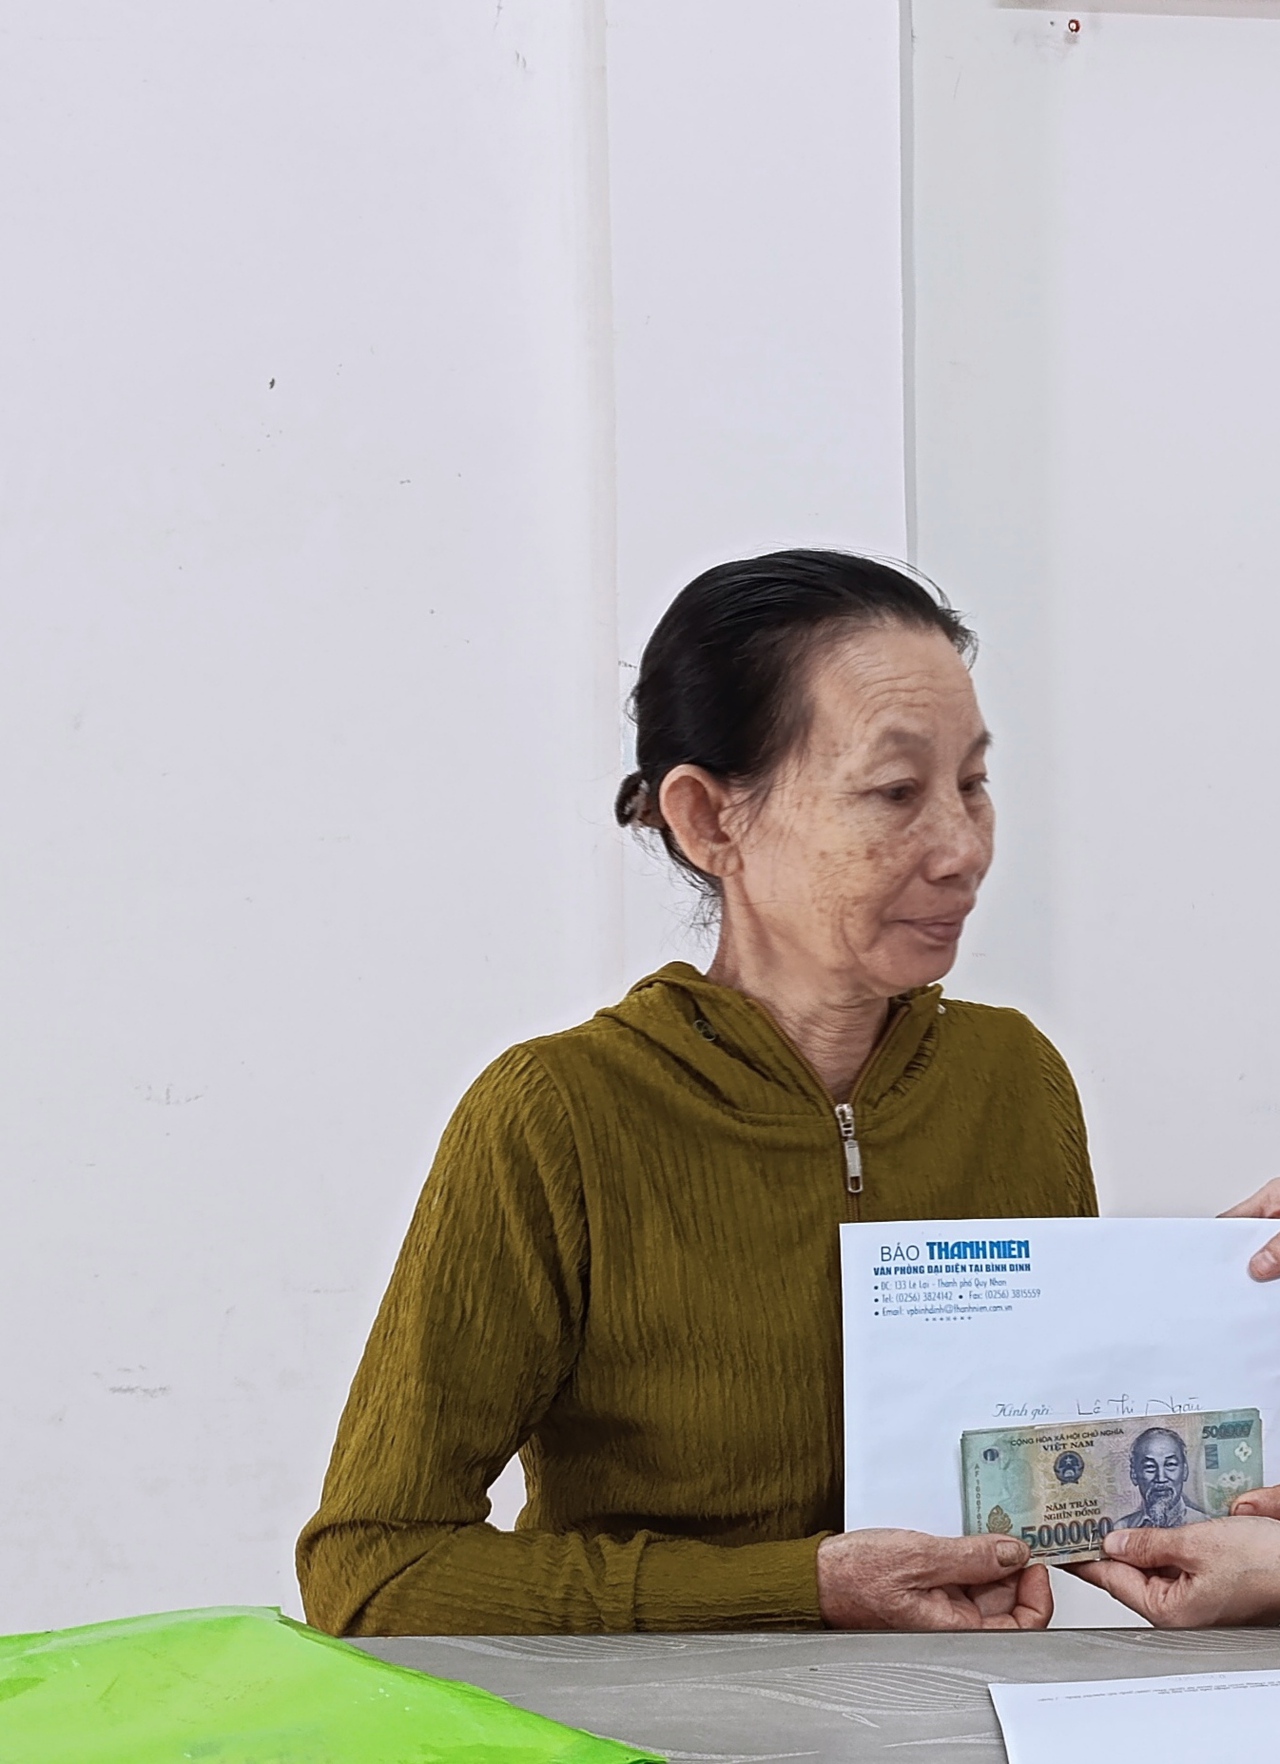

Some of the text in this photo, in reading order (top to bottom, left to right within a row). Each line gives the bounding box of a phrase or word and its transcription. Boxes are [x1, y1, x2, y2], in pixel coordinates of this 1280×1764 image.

[881, 1242, 920, 1262] BÁO
[926, 1240, 987, 1260] THANH
[894, 1263, 925, 1275] PHÒNG
[985, 1262, 1007, 1273] BÌNH
[974, 1277, 988, 1289] Quy
[896, 1292, 920, 1303] (0256)
[923, 1291, 953, 1302] 3824142
[985, 1289, 1009, 1299] (0256)
[1011, 1288, 1041, 1299] 3815559
[1076, 1399, 1101, 1416] Lê
[1010, 1437, 1034, 1447] CỘNG
[1066, 1431, 1081, 1440] HỘI
[1042, 1440, 1095, 1452] VIỆT NAM
[1045, 1502, 1067, 1512] NĂM
